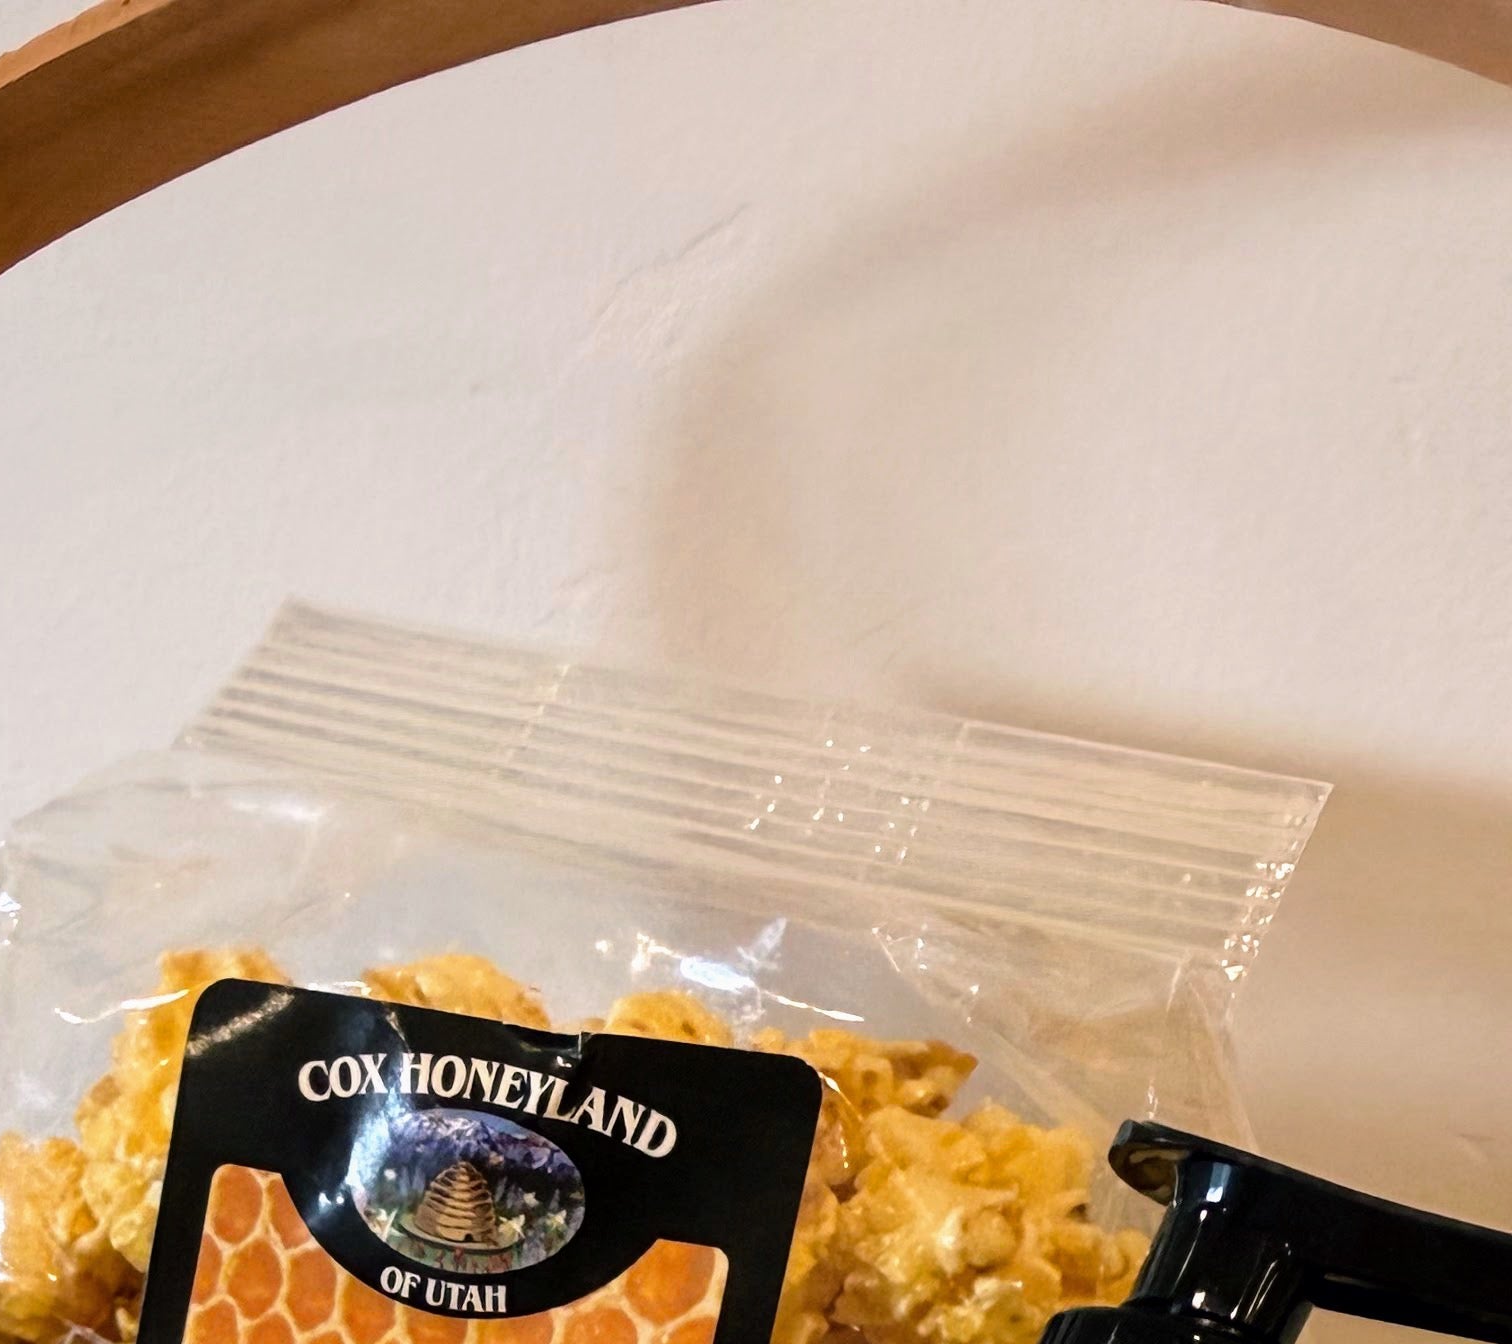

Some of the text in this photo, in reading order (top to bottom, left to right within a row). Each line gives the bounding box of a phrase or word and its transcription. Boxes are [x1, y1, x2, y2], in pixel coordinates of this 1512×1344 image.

[298, 1052, 678, 1160] COX HONEYLAND
[380, 1266, 507, 1313] OF UTAH
